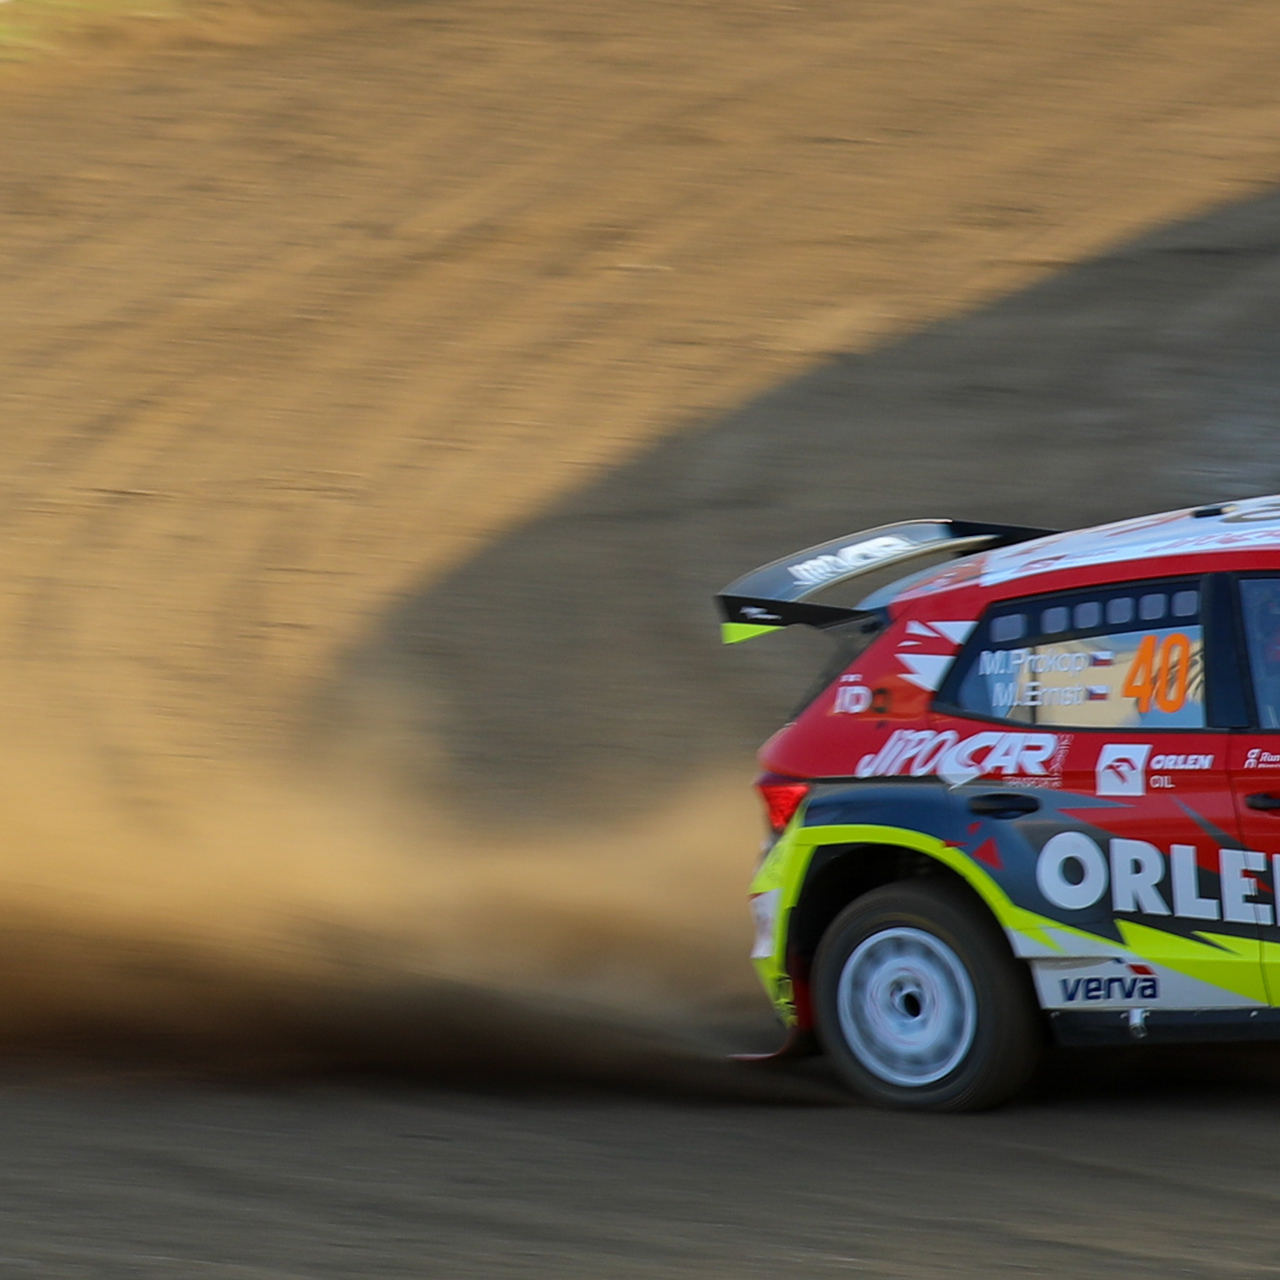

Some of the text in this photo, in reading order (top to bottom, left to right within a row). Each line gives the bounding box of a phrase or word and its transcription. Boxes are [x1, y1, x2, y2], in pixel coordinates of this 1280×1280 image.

[1122, 632, 1191, 714] 40
[855, 729, 1060, 791] JIPOCAR
[1150, 753, 1215, 770] ORLEN
[1150, 774, 1175, 788] OIL
[1060, 973, 1159, 1002] verva
